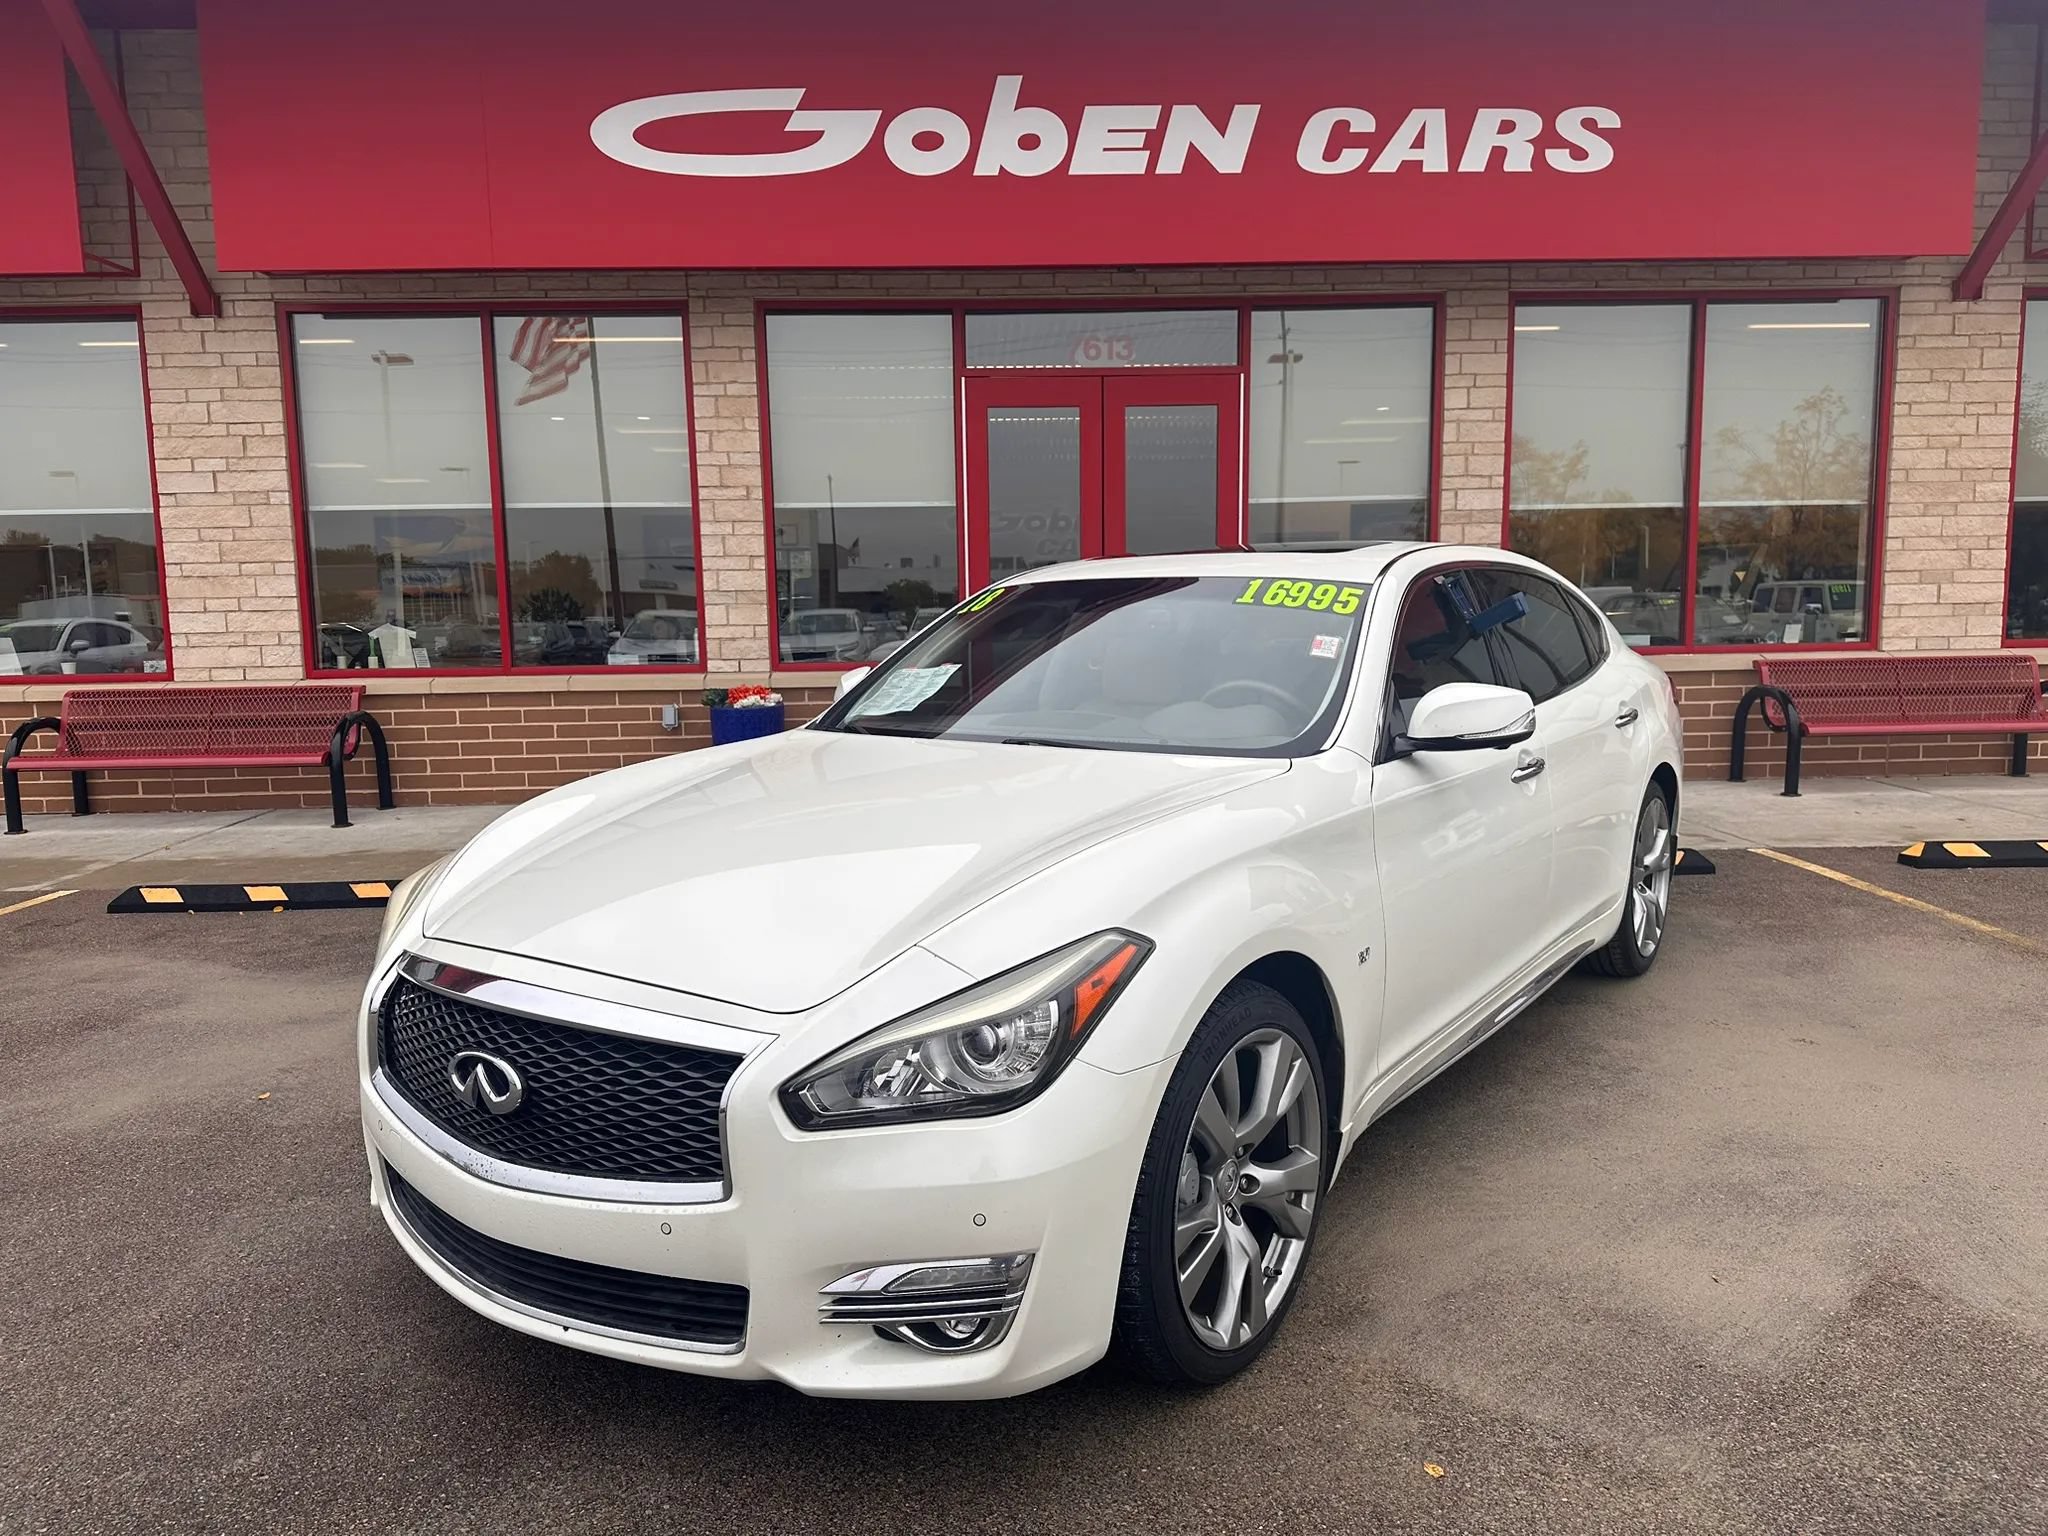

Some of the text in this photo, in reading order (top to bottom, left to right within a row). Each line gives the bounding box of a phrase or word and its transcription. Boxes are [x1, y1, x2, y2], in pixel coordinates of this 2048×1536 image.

[1296, 105, 1622, 175] CARS
[957, 587, 1006, 614] 18
[1235, 578, 1365, 615] 16995
